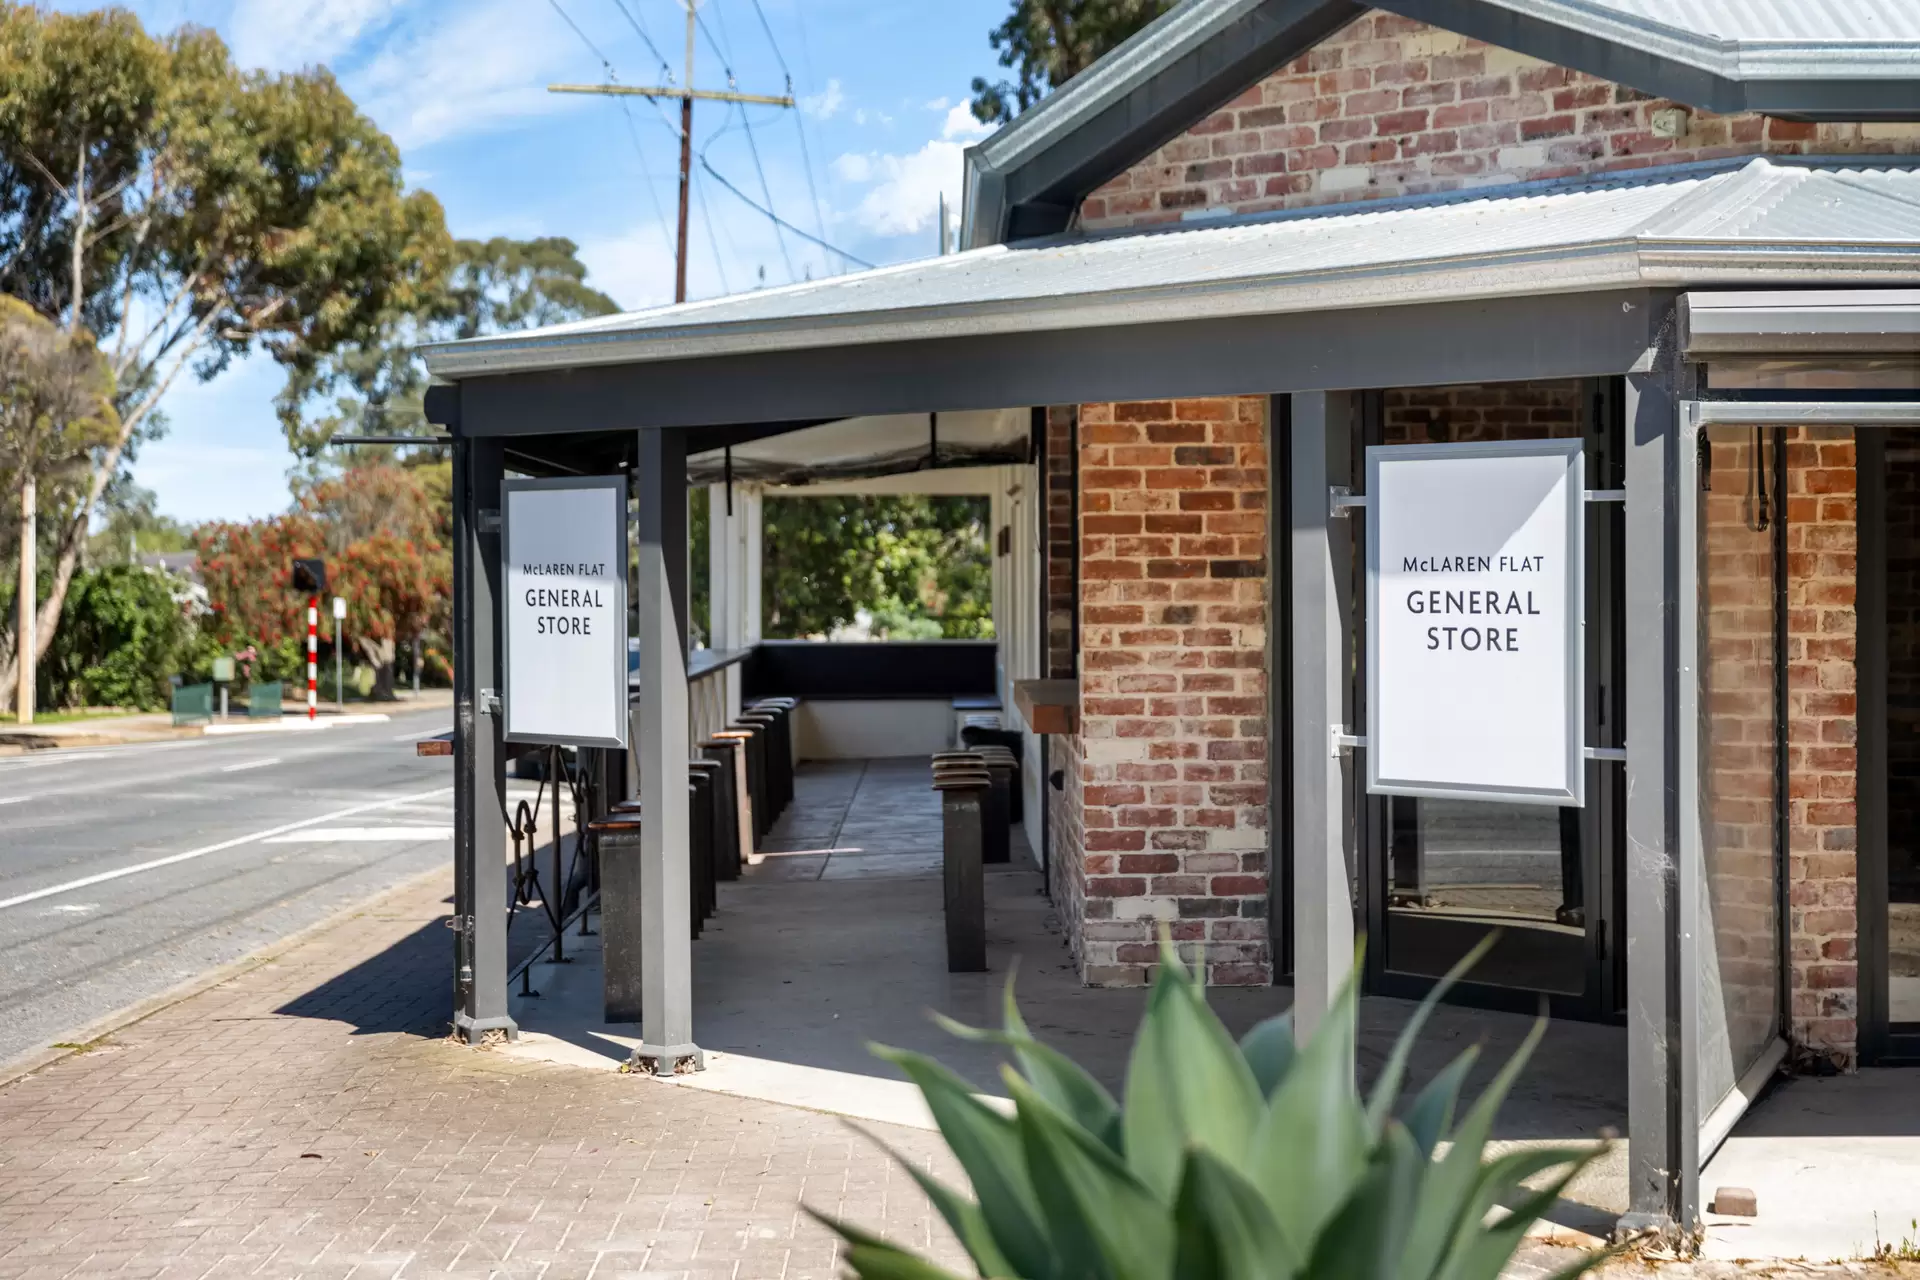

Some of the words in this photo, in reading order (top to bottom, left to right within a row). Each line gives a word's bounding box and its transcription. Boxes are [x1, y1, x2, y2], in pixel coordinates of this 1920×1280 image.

[523, 563, 573, 576] McLAREN
[579, 563, 605, 576] FLAT
[1403, 556, 1491, 572] McLAREN
[1501, 556, 1544, 572] FLAT
[526, 589, 603, 608] GENERAL
[1407, 590, 1540, 615] GENERAL
[538, 616, 591, 635] STORE
[1427, 626, 1519, 652] STORE
